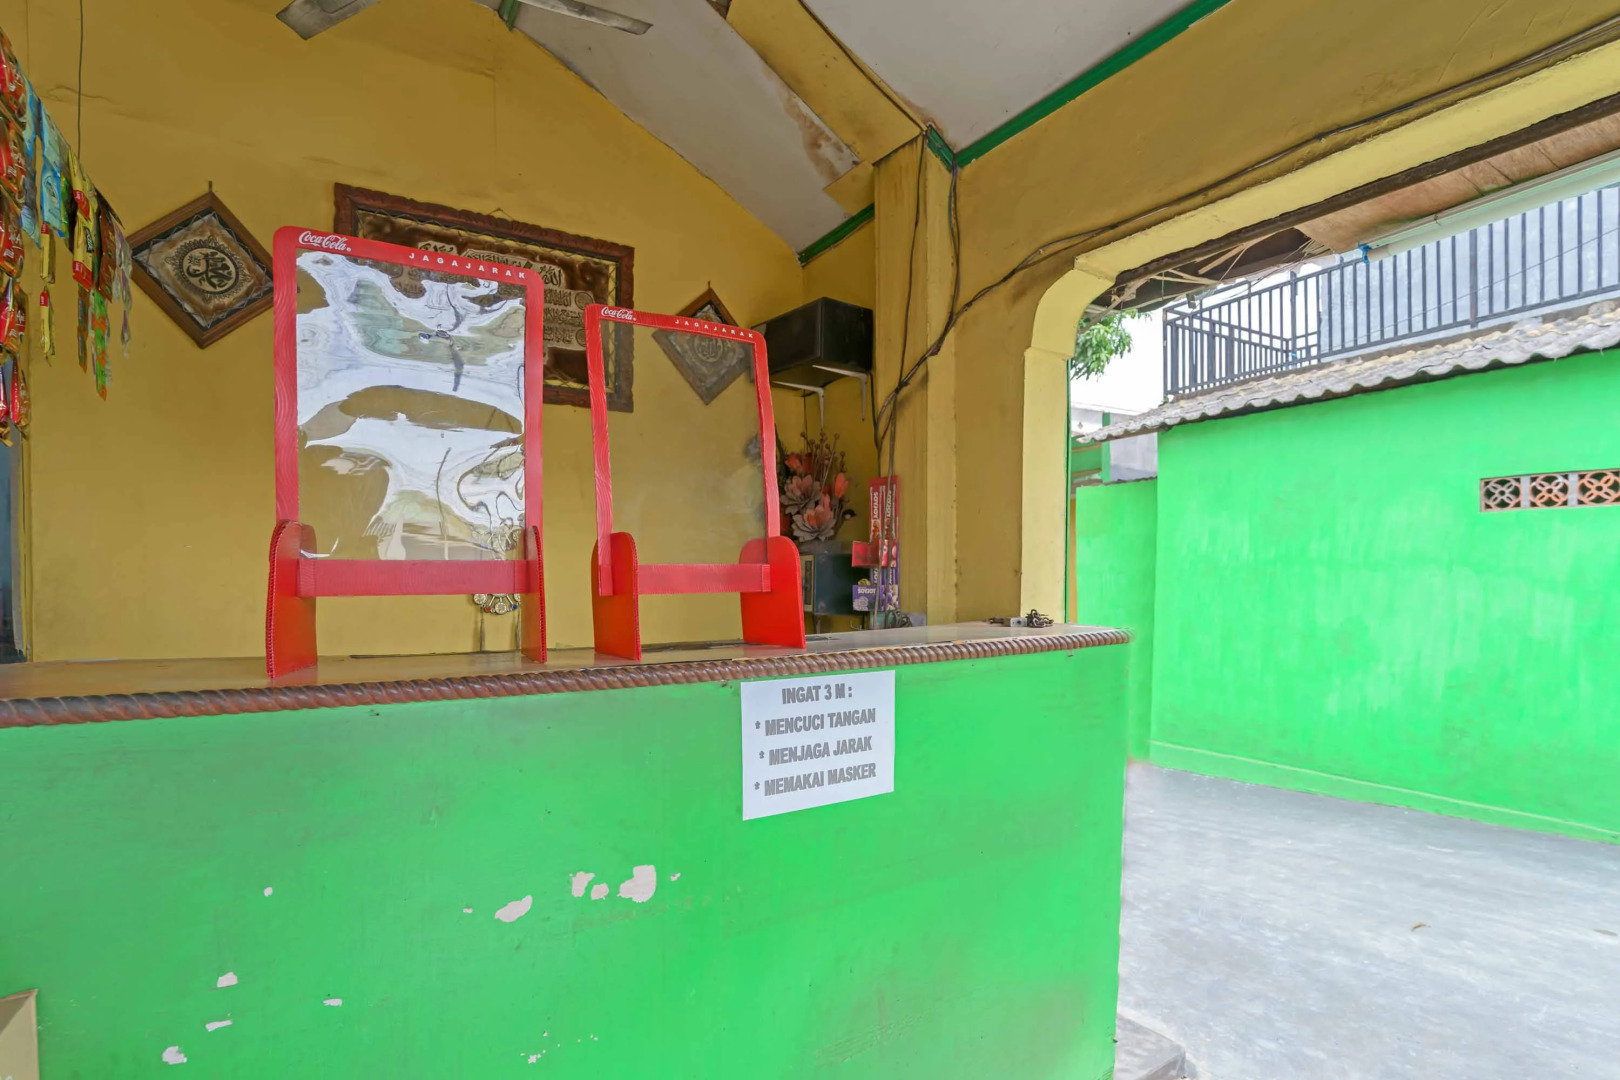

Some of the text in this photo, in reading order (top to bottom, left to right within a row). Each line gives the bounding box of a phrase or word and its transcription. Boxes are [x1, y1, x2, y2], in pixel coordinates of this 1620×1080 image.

[298, 231, 347, 251] Coca-Cola
[601, 306, 633, 320] Coca-Cola
[782, 685, 821, 704] INGAT
[824, 684, 832, 700] 3
[765, 708, 876, 736] MENCUCI TANGAN
[769, 736, 872, 765] MENJAGA JARAK
[764, 763, 876, 796] MEMAKAI MASKER
